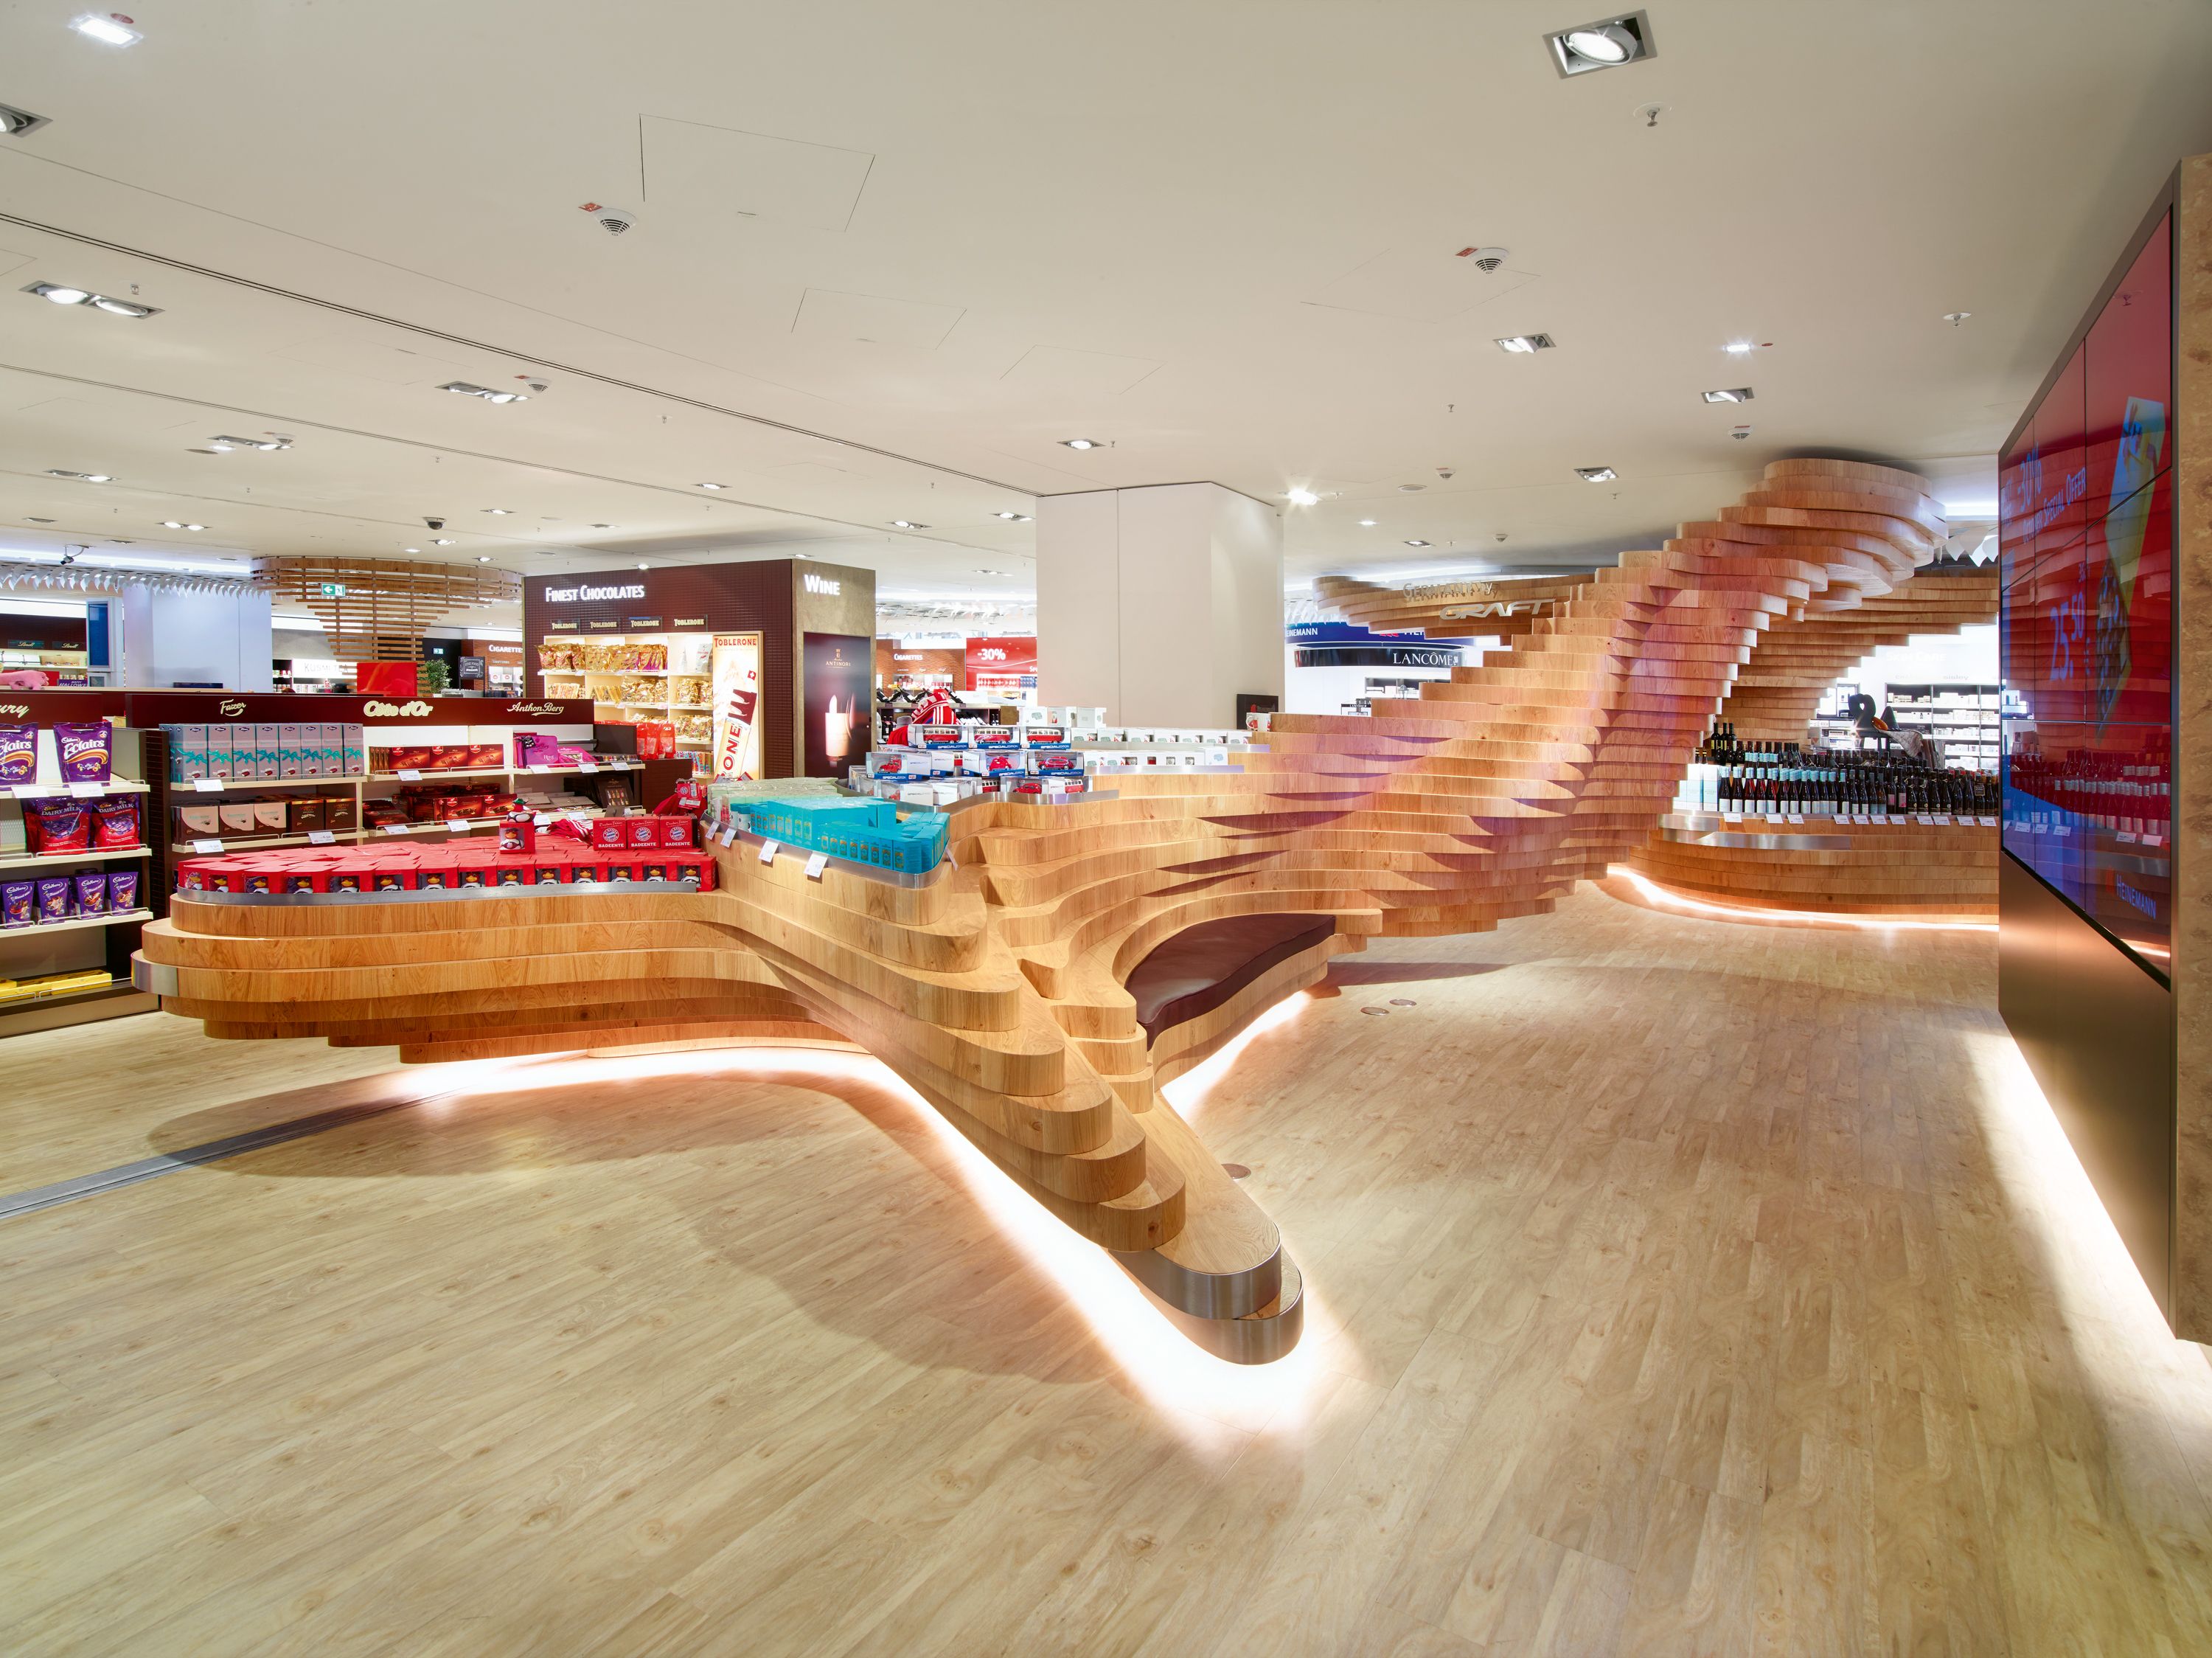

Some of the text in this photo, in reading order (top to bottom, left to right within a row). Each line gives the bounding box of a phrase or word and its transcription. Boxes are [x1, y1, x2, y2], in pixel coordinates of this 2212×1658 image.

[2017, 441, 2042, 513] -30%
[2043, 489, 2065, 527] SPECIAL
[2065, 467, 2086, 506] OFFER
[546, 585, 644, 602] FINEST CHOCOLATES
[804, 574, 841, 596] WINE
[1439, 598, 1557, 620] GRAFT
[630, 620, 659, 628] TOBLERONE
[674, 618, 704, 626] TOBLERONE
[714, 638, 757, 646] TOBLERONE
[977, 648, 1006, 661] -30%
[1393, 652, 1453, 666] LANCÔME
[220, 698, 246, 716] Fazer
[507, 702, 564, 715] Anthon Berg
[63, 739, 105, 760] Eclairs
[2116, 874, 2157, 920] HEINEMANN
